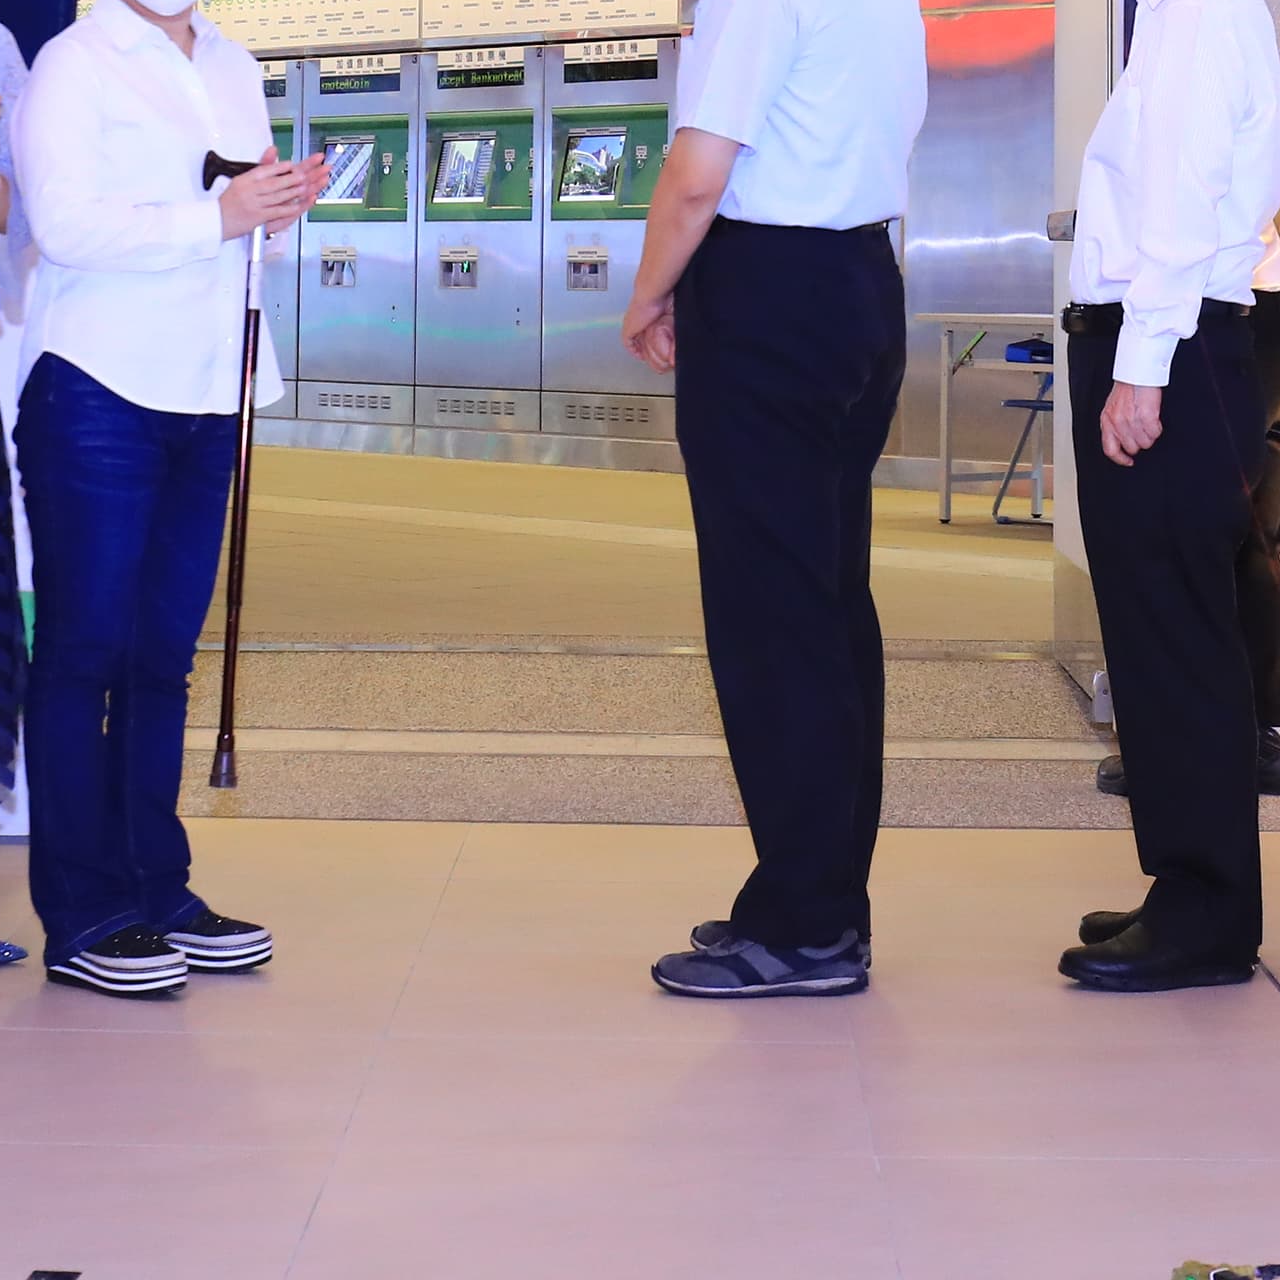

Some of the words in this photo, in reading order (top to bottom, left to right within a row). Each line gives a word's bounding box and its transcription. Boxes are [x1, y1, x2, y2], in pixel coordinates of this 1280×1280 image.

[537, 47, 543, 58] 2
[411, 55, 418, 64] 3
[296, 61, 301, 70] 4
